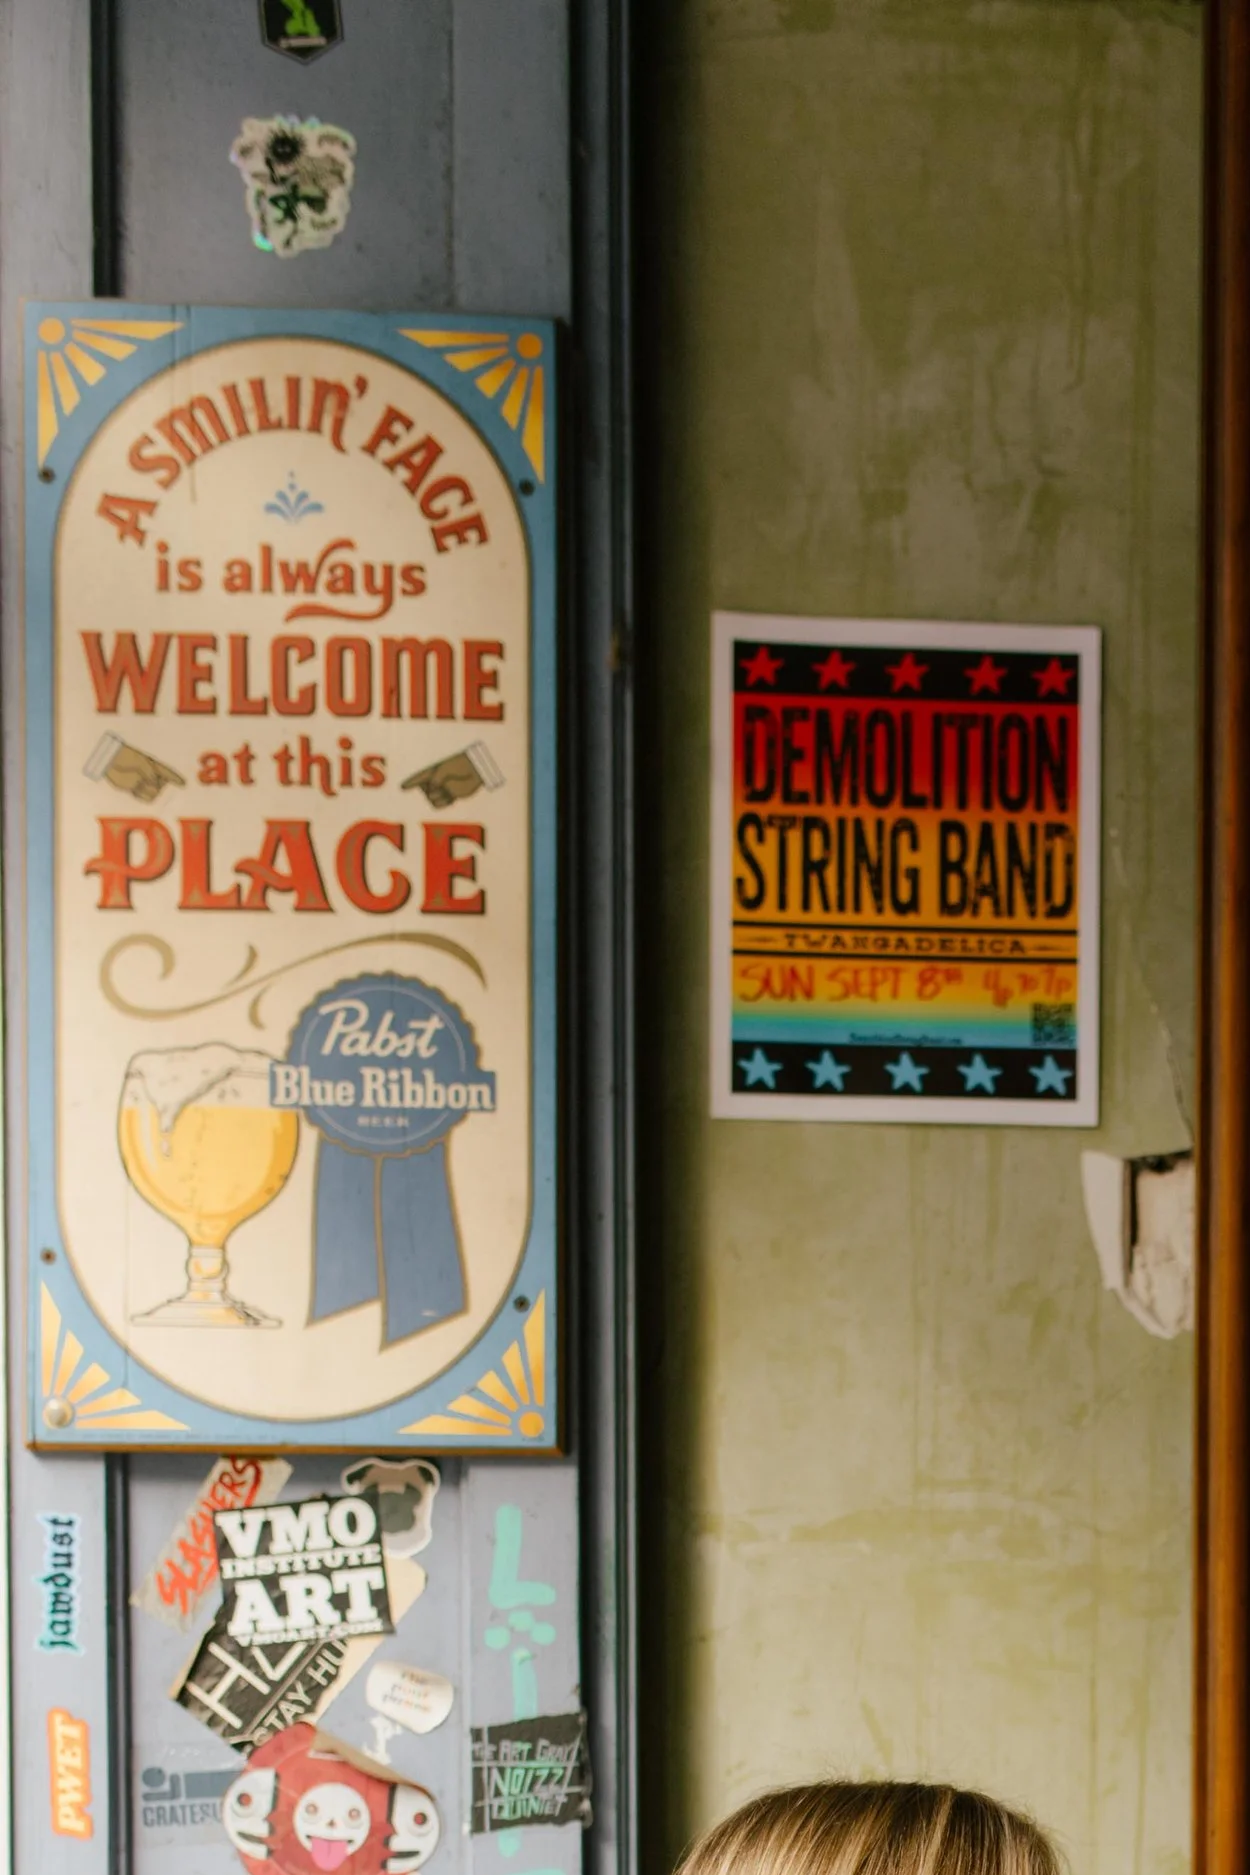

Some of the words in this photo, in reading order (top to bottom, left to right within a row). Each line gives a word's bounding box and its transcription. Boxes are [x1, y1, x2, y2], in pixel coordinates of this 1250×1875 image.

[97, 491, 159, 547] A
[362, 405, 488, 554] FACE
[156, 541, 204, 593] is
[223, 538, 427, 622] always
[80, 630, 505, 722] WELCOME
[198, 743, 256, 787] at
[276, 735, 387, 797] this
[742, 704, 1070, 813] DEMOLITION
[85, 817, 487, 915] PLACE
[735, 812, 921, 917] STRING
[937, 819, 1075, 920] BAND
[783, 932, 1028, 956] TWANGADELICA
[739, 963, 816, 1002] SUN
[825, 964, 906, 1002] SEPT
[318, 998, 445, 1058] Pabst
[271, 1067, 355, 1109] Blue
[360, 1067, 496, 1112] Ribbon
[213, 1496, 378, 1558] VMO
[220, 1543, 382, 1580] INSTITUTE
[227, 1565, 385, 1637] ART
[498, 1739, 533, 1763] ART
